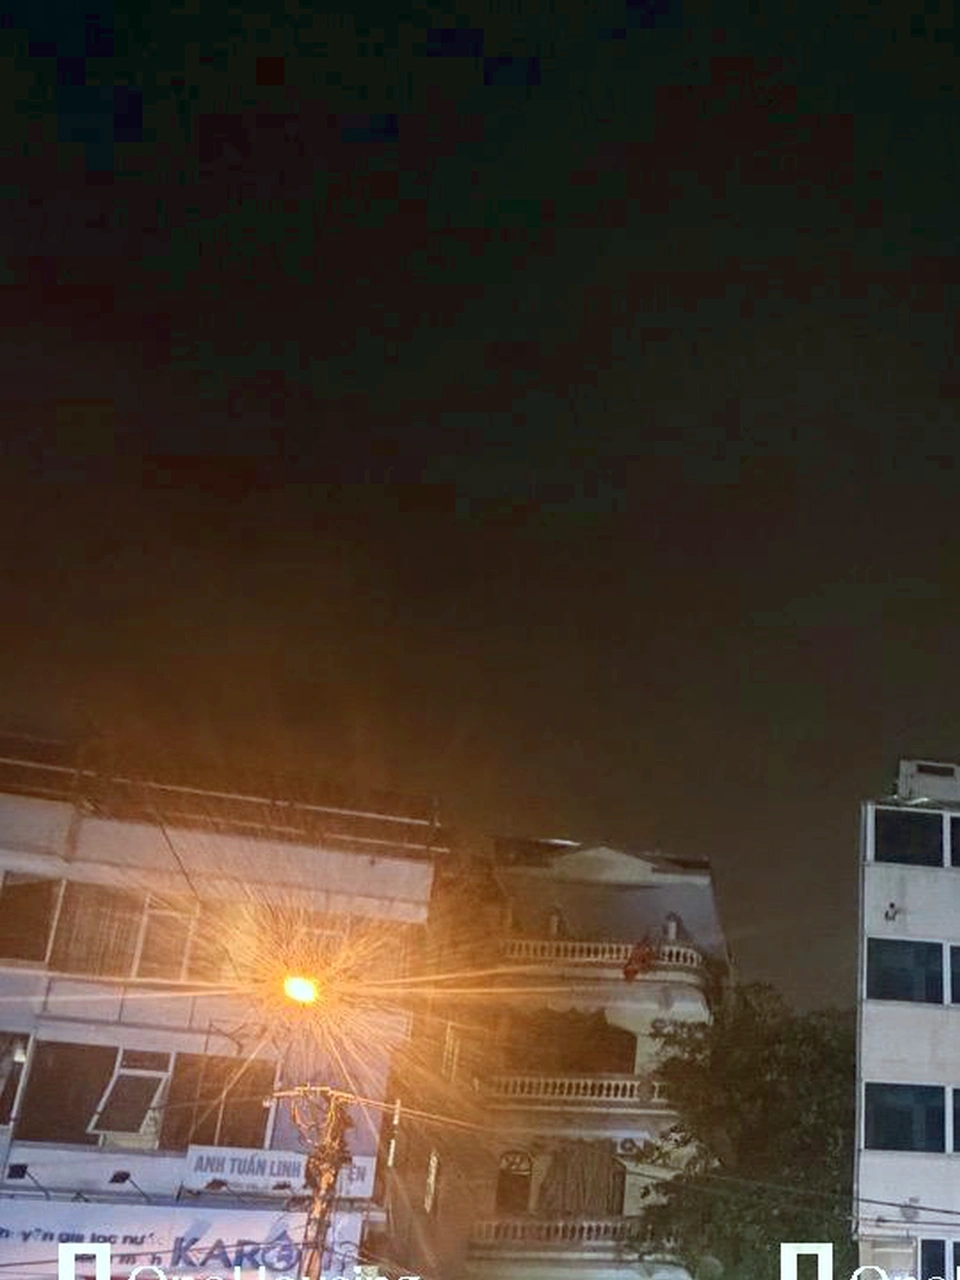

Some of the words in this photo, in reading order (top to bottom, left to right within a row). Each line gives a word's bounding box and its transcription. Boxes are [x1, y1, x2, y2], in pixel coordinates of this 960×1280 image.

[194, 1157, 225, 1173] ANH
[229, 1153, 266, 1178] TUẤN
[269, 1158, 302, 1179] LINH
